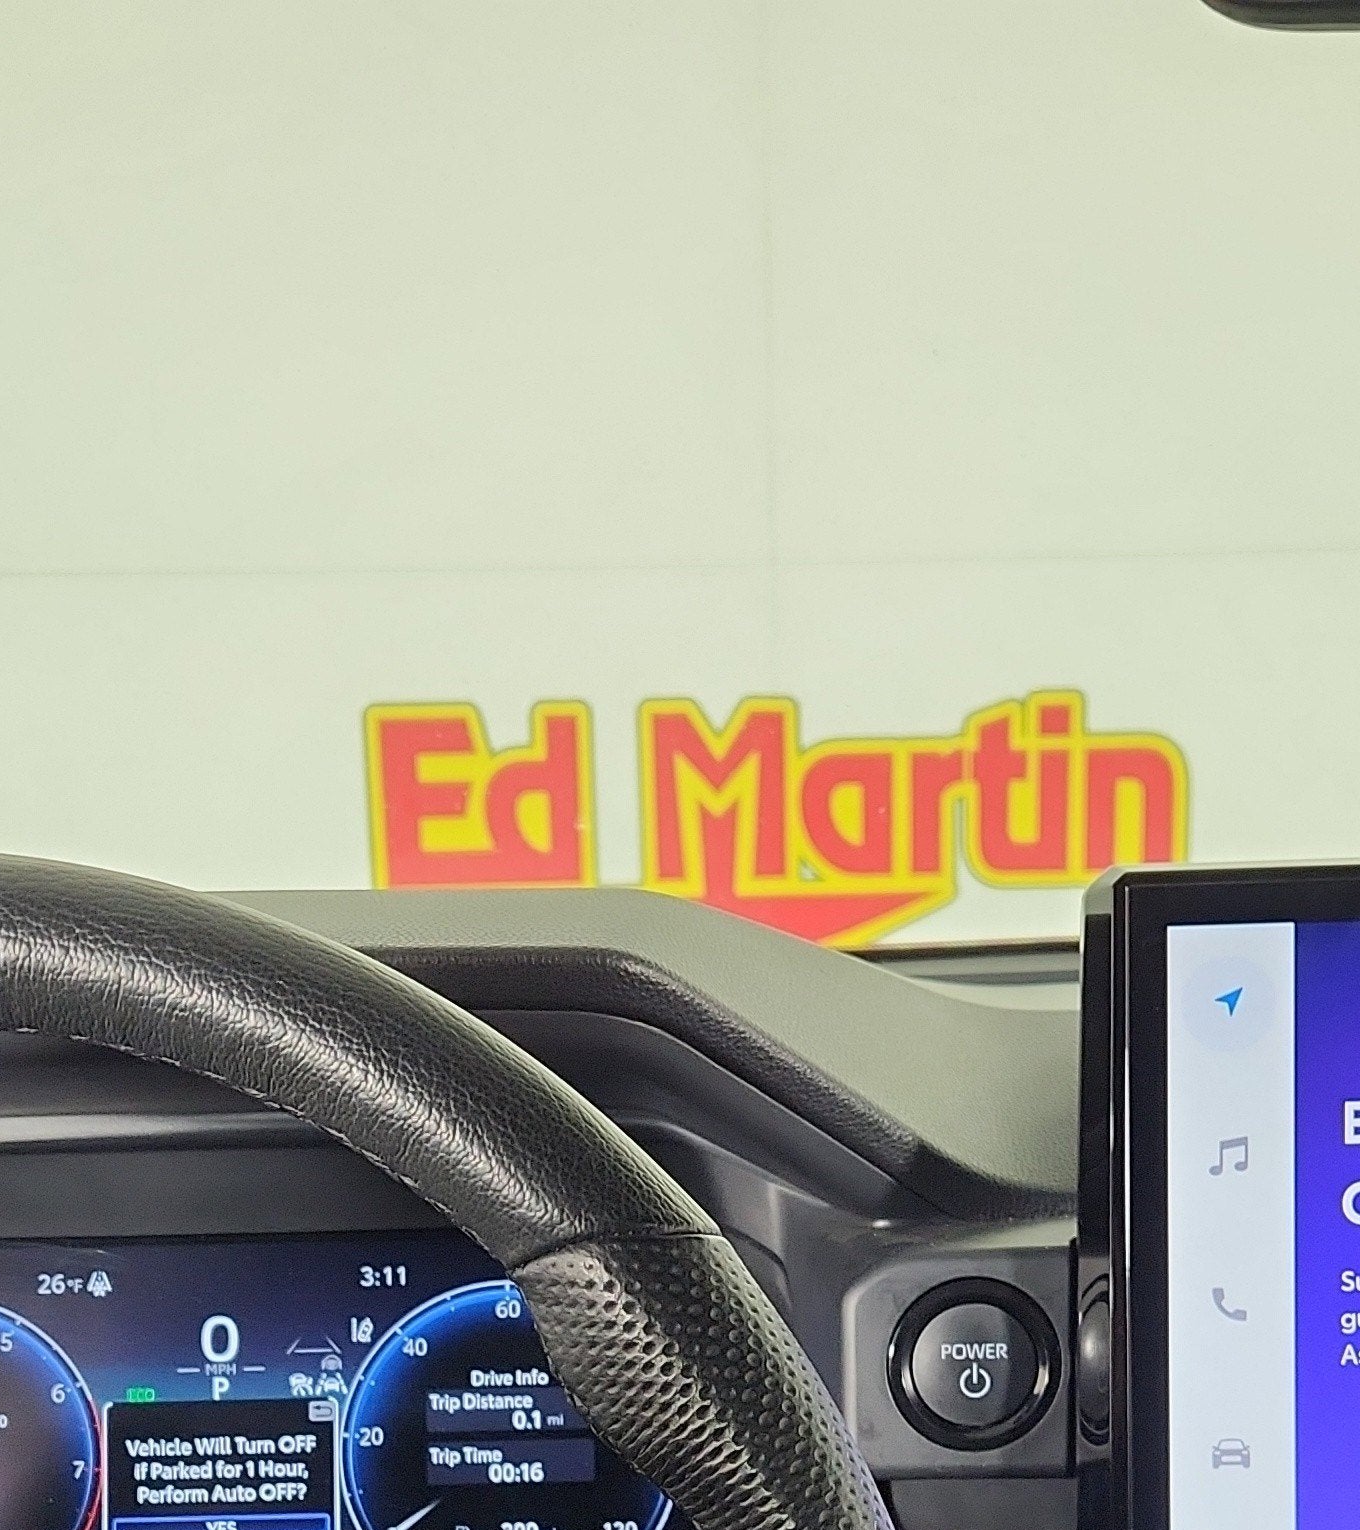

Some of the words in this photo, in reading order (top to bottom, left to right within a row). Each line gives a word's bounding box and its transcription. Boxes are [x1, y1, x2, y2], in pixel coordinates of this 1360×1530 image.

[366, 702, 593, 888] Ed
[640, 690, 1190, 890] Martin
[359, 1265, 408, 1288] 3:11
[494, 1300, 521, 1320] 60
[200, 1315, 239, 1364] 0
[401, 1337, 429, 1357] 40
[940, 1342, 1009, 1361] POWER
[205, 1363, 238, 1376] MPH
[470, 1370, 513, 1388] Drive
[516, 1369, 550, 1388] Info
[50, 1384, 67, 1404] 6
[213, 1376, 230, 1399] P
[429, 1393, 462, 1412] Trip
[464, 1392, 534, 1411] Distance
[512, 1410, 542, 1430] 0.1
[547, 1413, 565, 1426] mi
[125, 1437, 194, 1458] Vehicle
[196, 1436, 233, 1457] Will
[235, 1436, 276, 1456] Turn
[278, 1434, 317, 1455] OFF
[359, 1426, 385, 1447] 20
[429, 1447, 462, 1466] Trip
[464, 1446, 503, 1465] Time
[72, 1460, 86, 1479] 7
[134, 1461, 147, 1481] If
[149, 1460, 213, 1481] Parked
[215, 1460, 242, 1480] for
[245, 1460, 255, 1479] 1
[257, 1459, 310, 1480] Hour,
[488, 1463, 545, 1484] 00:16
[136, 1484, 208, 1506] Perform
[210, 1483, 257, 1503] Auto
[258, 1481, 308, 1502] OFF?
